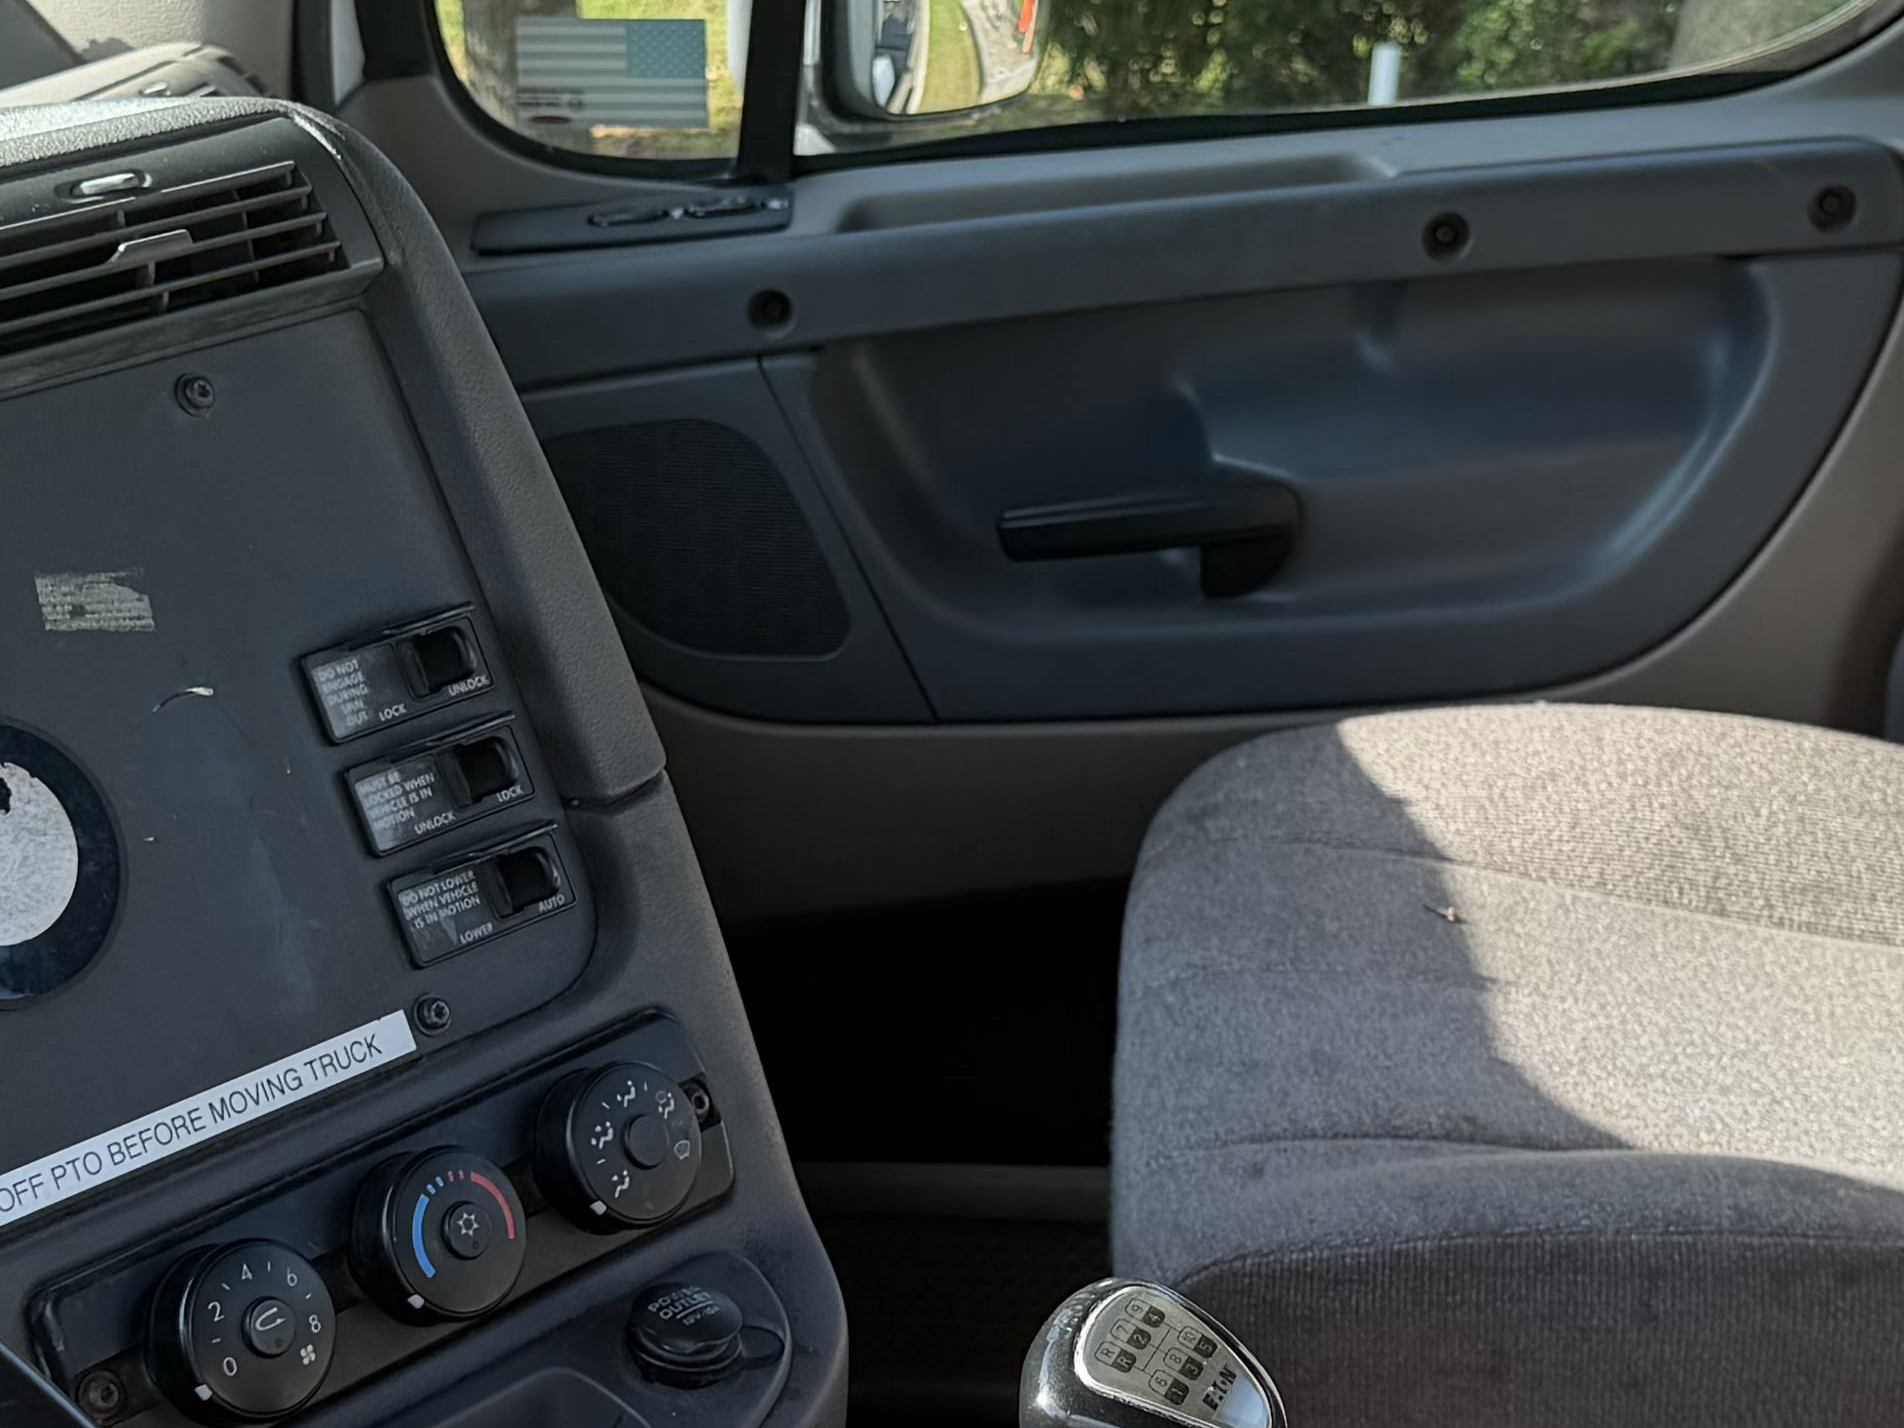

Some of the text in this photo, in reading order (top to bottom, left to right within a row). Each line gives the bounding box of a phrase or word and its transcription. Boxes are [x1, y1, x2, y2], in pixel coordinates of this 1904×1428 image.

[337, 659, 359, 676] NOT
[322, 673, 366, 693] ENGAGE
[448, 674, 490, 697] UNLOCK
[378, 702, 407, 722] LOCK
[403, 772, 436, 793] WHEN
[420, 787, 434, 801] IN
[496, 784, 524, 803] LOCK
[414, 810, 457, 835] UNLOCK
[418, 882, 441, 900] NOT
[440, 869, 475, 892] LOWER
[405, 881, 480, 920] WHEN VEHICLE
[539, 893, 565, 913] AUTO
[414, 895, 481, 929] IS IN MOTION
[460, 922, 494, 945] LOWER
[51, 1151, 103, 1190] PTO
[107, 1107, 207, 1167] BEFORE
[209, 1067, 305, 1124] MOVING
[304, 1033, 383, 1082] TRUCK
[241, 1263, 253, 1281] 4
[286, 1267, 298, 1287] 6
[207, 1301, 225, 1322] 2
[309, 1314, 322, 1333] 8
[1099, 1347, 1116, 1359] R
[1118, 1355, 1133, 1368] R
[222, 1356, 238, 1377] 0
